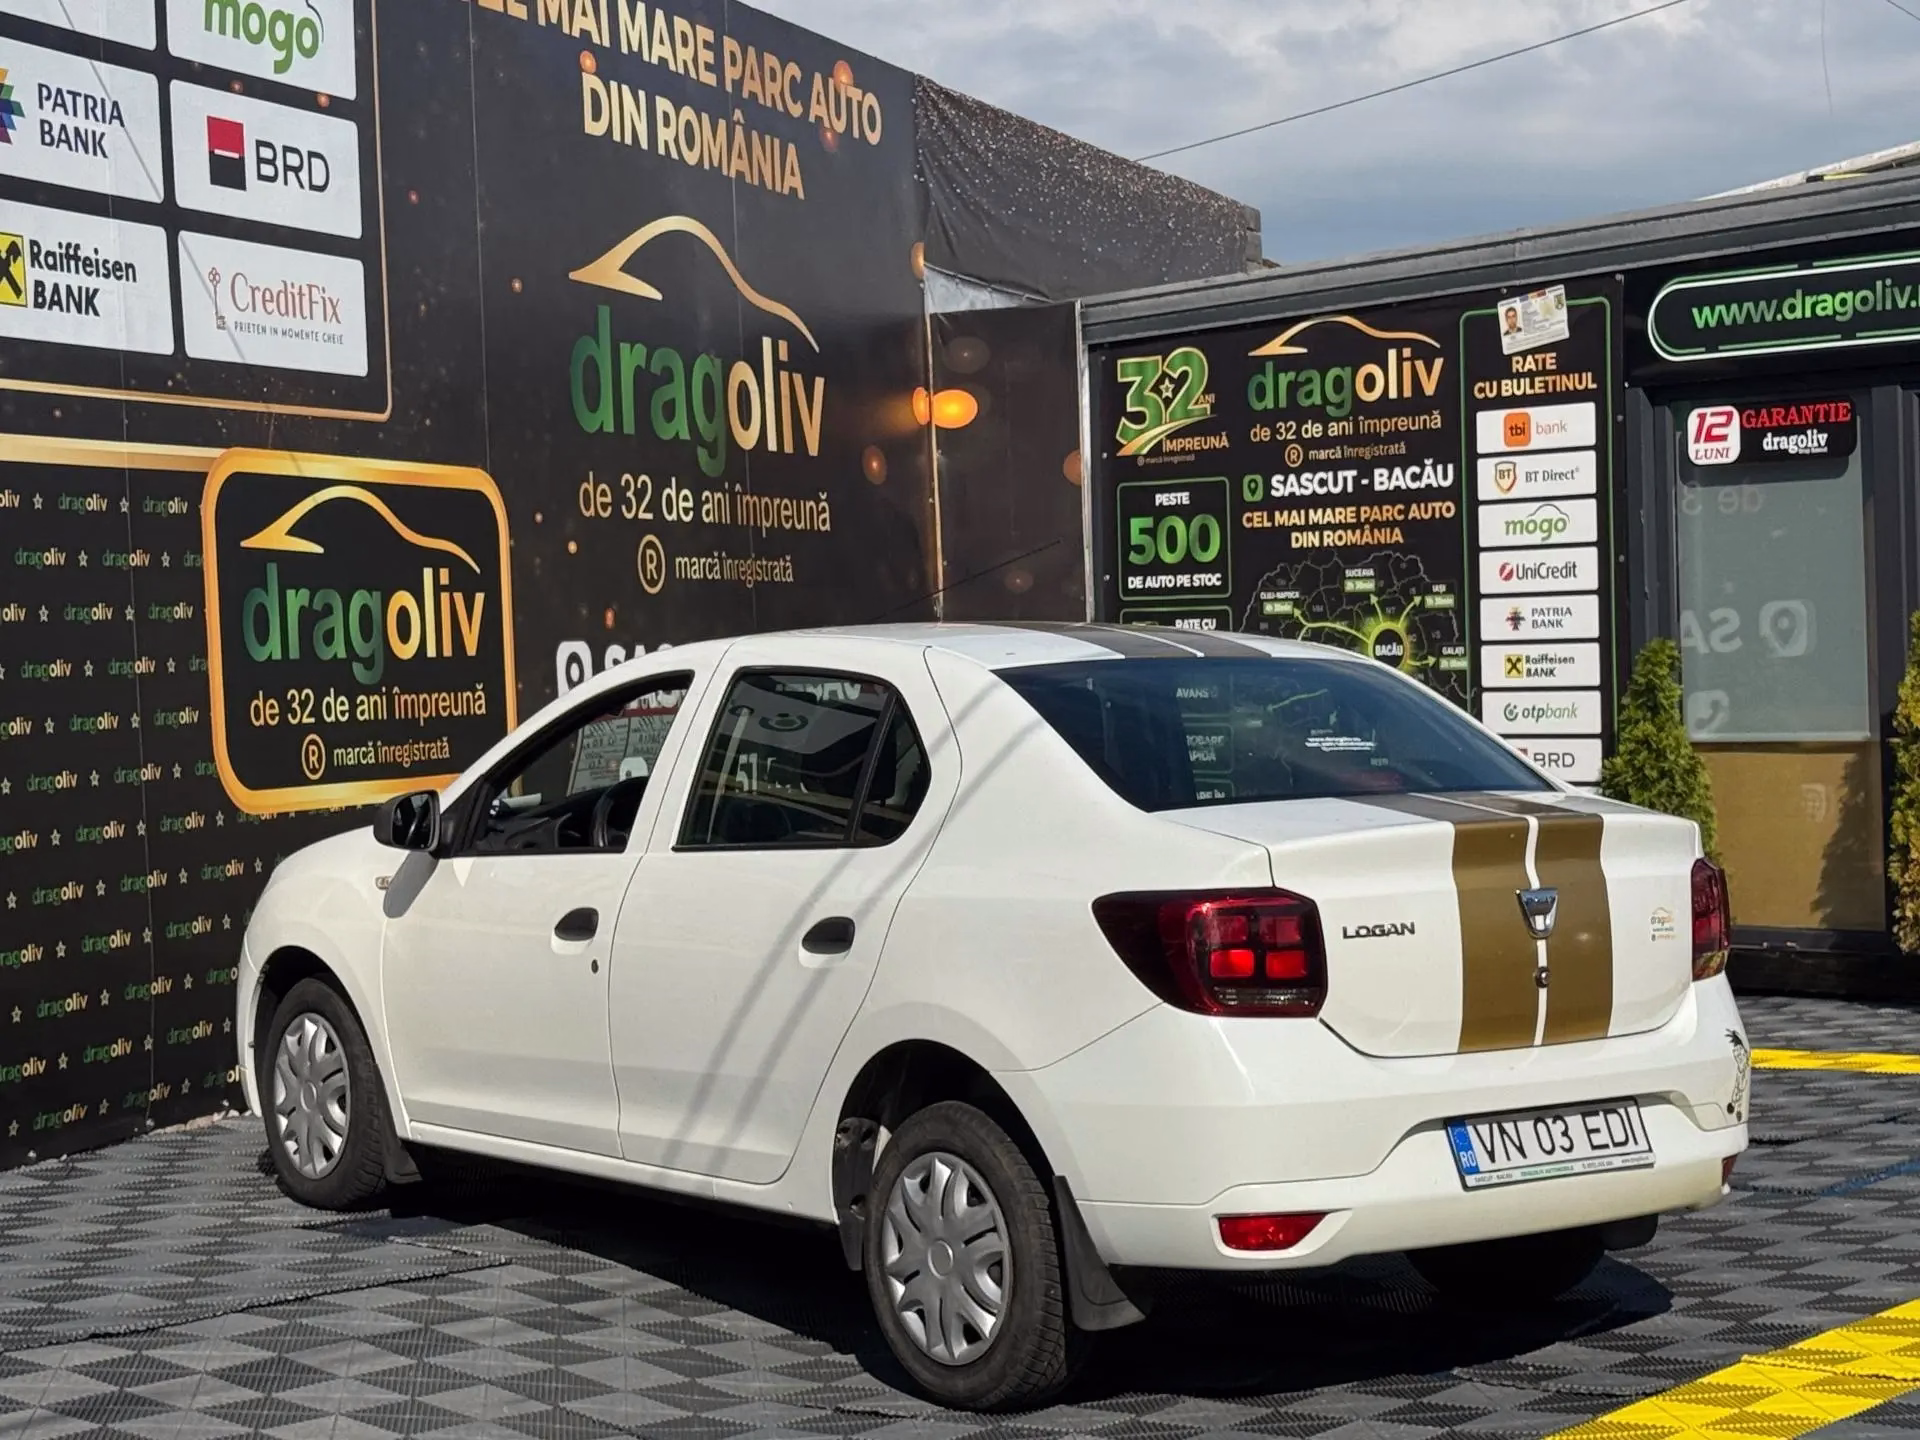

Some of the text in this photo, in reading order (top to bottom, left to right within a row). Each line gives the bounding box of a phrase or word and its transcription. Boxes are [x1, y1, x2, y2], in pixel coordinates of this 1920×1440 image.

[203, 0, 320, 74] mogo
[618, 0, 718, 87] MARE
[722, 35, 804, 117] PARC
[809, 72, 882, 145] AUTO
[38, 82, 126, 128] PATRIA
[39, 119, 109, 159] BANK
[581, 72, 805, 200] DIN ROMÂNIA
[254, 139, 331, 193] BRD
[29, 239, 137, 283] Raiffeisen
[33, 280, 101, 317] BANK
[230, 271, 342, 325] CreditFix
[1692, 277, 1920, 329] www.dragoliv.
[234, 320, 267, 334] PRIETEN
[269, 326, 278, 337] IN
[281, 328, 319, 342] MOMENTE
[1511, 352, 1558, 374] RATE
[569, 304, 826, 477] dragoliv
[1115, 346, 1209, 445] 32
[1247, 347, 1445, 418] dragoliv
[1473, 371, 1598, 400] CU BULETINUL
[1250, 410, 1442, 442] de 32 de ani împreună
[1508, 421, 1568, 437] tbi bank
[1693, 411, 1735, 445] 12
[1742, 402, 1852, 429] GARANTIE
[1308, 446, 1342, 461] marcă
[1343, 440, 1407, 460] înregistrată
[1694, 448, 1731, 461] LUNI
[1762, 429, 1828, 454] dragoliv
[1270, 470, 1358, 498] SASCUT
[1373, 457, 1455, 492] BACĂU
[1525, 471, 1540, 484] BT
[0, 489, 189, 518] oliv dragoliv dragoliv
[579, 471, 832, 538] de 32 de ani împreună
[1155, 491, 1191, 506] PESTE
[1242, 500, 1457, 529] CEL MAI MARE PARC AUTO
[1128, 512, 1222, 566] 500
[1291, 525, 1404, 549] DIN ROMÂNIA
[1504, 516, 1568, 543] mogo
[15, 547, 151, 571] dragoliv dragoliv
[675, 551, 722, 580] marcă
[722, 552, 795, 588] înregistrată
[1516, 560, 1578, 580] UniCredit
[1127, 572, 1222, 589] DE AUTO PE STOC
[0, 601, 194, 625] oliv dragoliv dragoliv
[242, 561, 486, 686] dragoliv
[1531, 606, 1573, 618] PATRIA
[1531, 618, 1564, 630] BANK
[1375, 642, 1404, 657] BACĂU
[1525, 652, 1576, 666] Raiffeisen
[21, 656, 156, 682] dragoliv dragoliv
[1525, 668, 1557, 678] BANK
[250, 682, 487, 727] de 32 de ani împreună
[1521, 702, 1579, 723] otpbank
[0, 706, 199, 740] goliv dragoliv dragoliv
[333, 740, 376, 767] marcă
[376, 736, 450, 769] înregistrată
[1533, 752, 1576, 768] BRD
[27, 762, 162, 794] dragoliv dragoliv
[0, 811, 206, 855] agoliv dragoliv dragoliv
[32, 881, 84, 906] dragoliv
[120, 869, 168, 894] dragoliv
[201, 859, 245, 882] dragoliv
[0, 915, 212, 970] ragoliv dragoliv dragoliv
[1342, 921, 1416, 940] LOGAN
[36, 966, 238, 1018] dragoliv dragoliv drago
[83, 1037, 133, 1064] dragoliv
[166, 1020, 213, 1045] dragoliv
[33, 1103, 88, 1131] dragoliv
[204, 1064, 240, 1089] dragol
[1471, 1105, 1640, 1165] VN 03 EDI
[1461, 1151, 1477, 1169] RO
